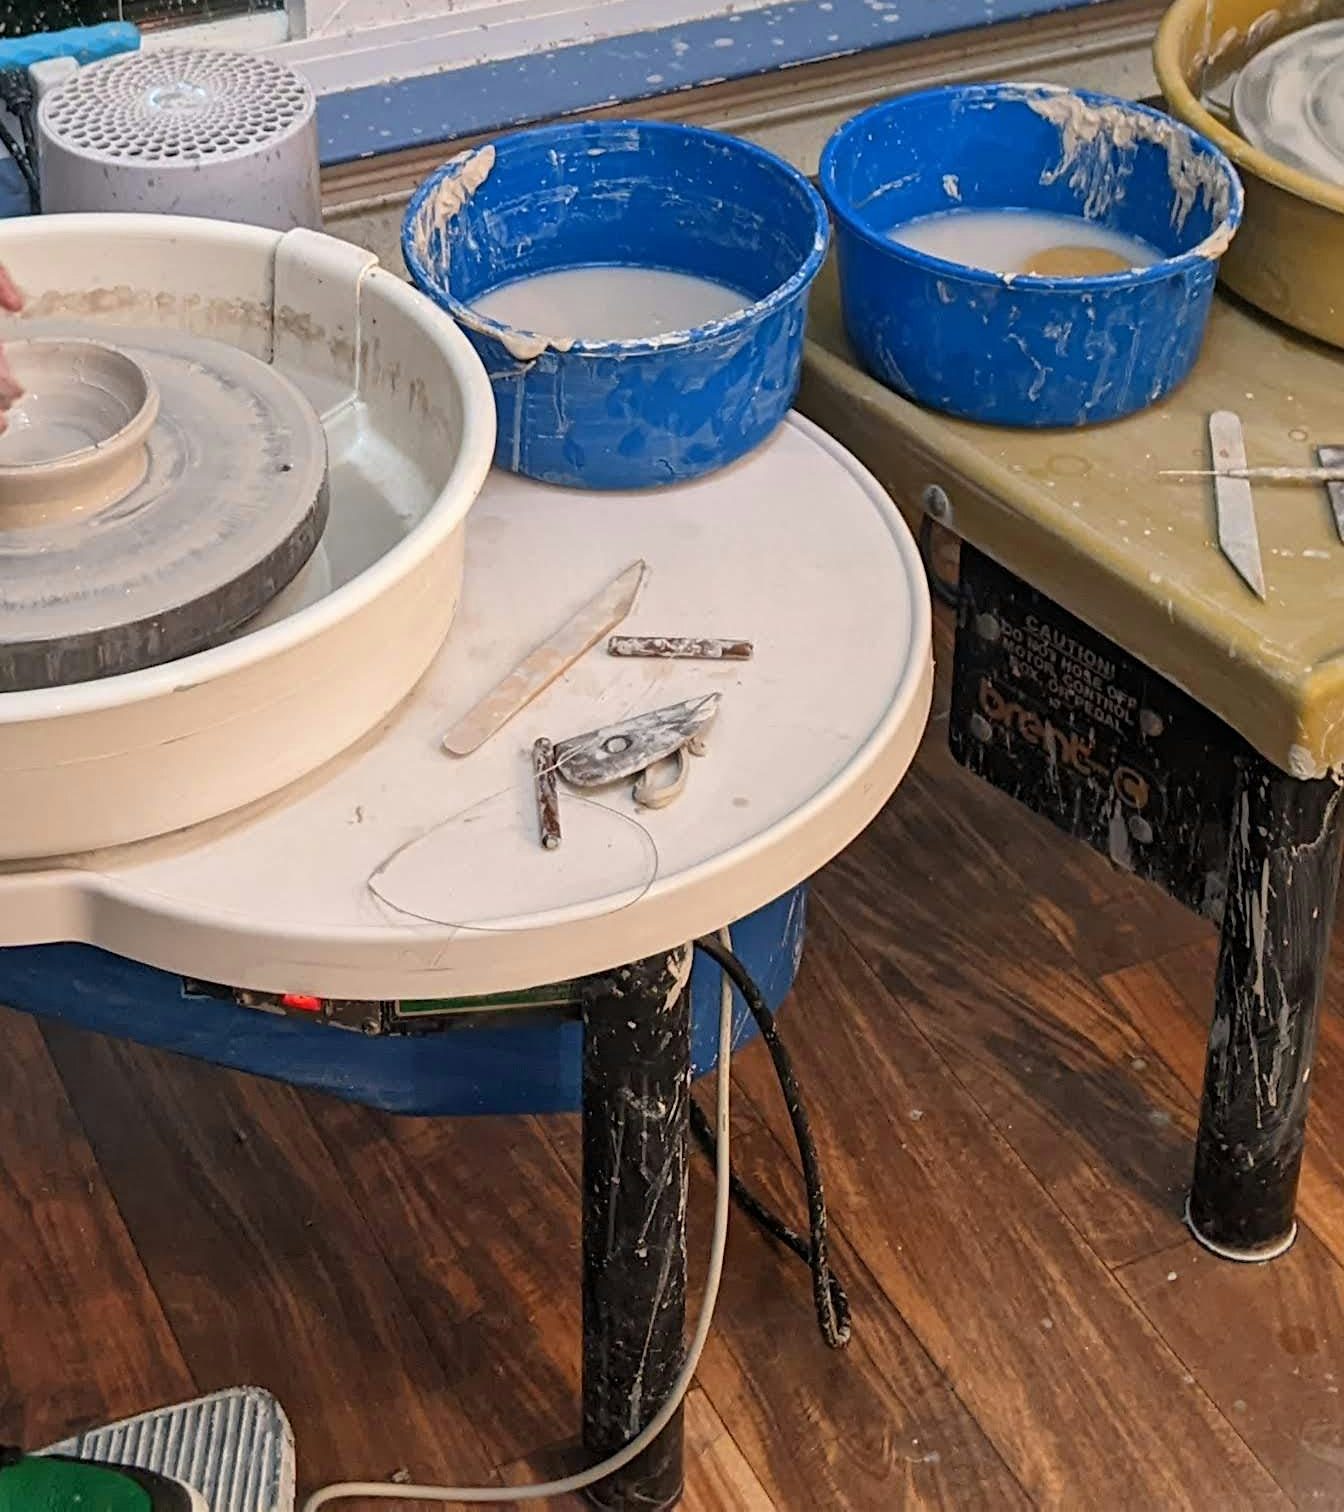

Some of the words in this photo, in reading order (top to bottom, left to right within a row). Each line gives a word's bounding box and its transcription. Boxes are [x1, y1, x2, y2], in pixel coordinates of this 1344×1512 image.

[1000, 618, 1024, 642] DO
[1060, 657, 1104, 691] HOSE
[1024, 615, 1117, 678] CAUTION!
[1061, 673, 1136, 726] CONTROL
